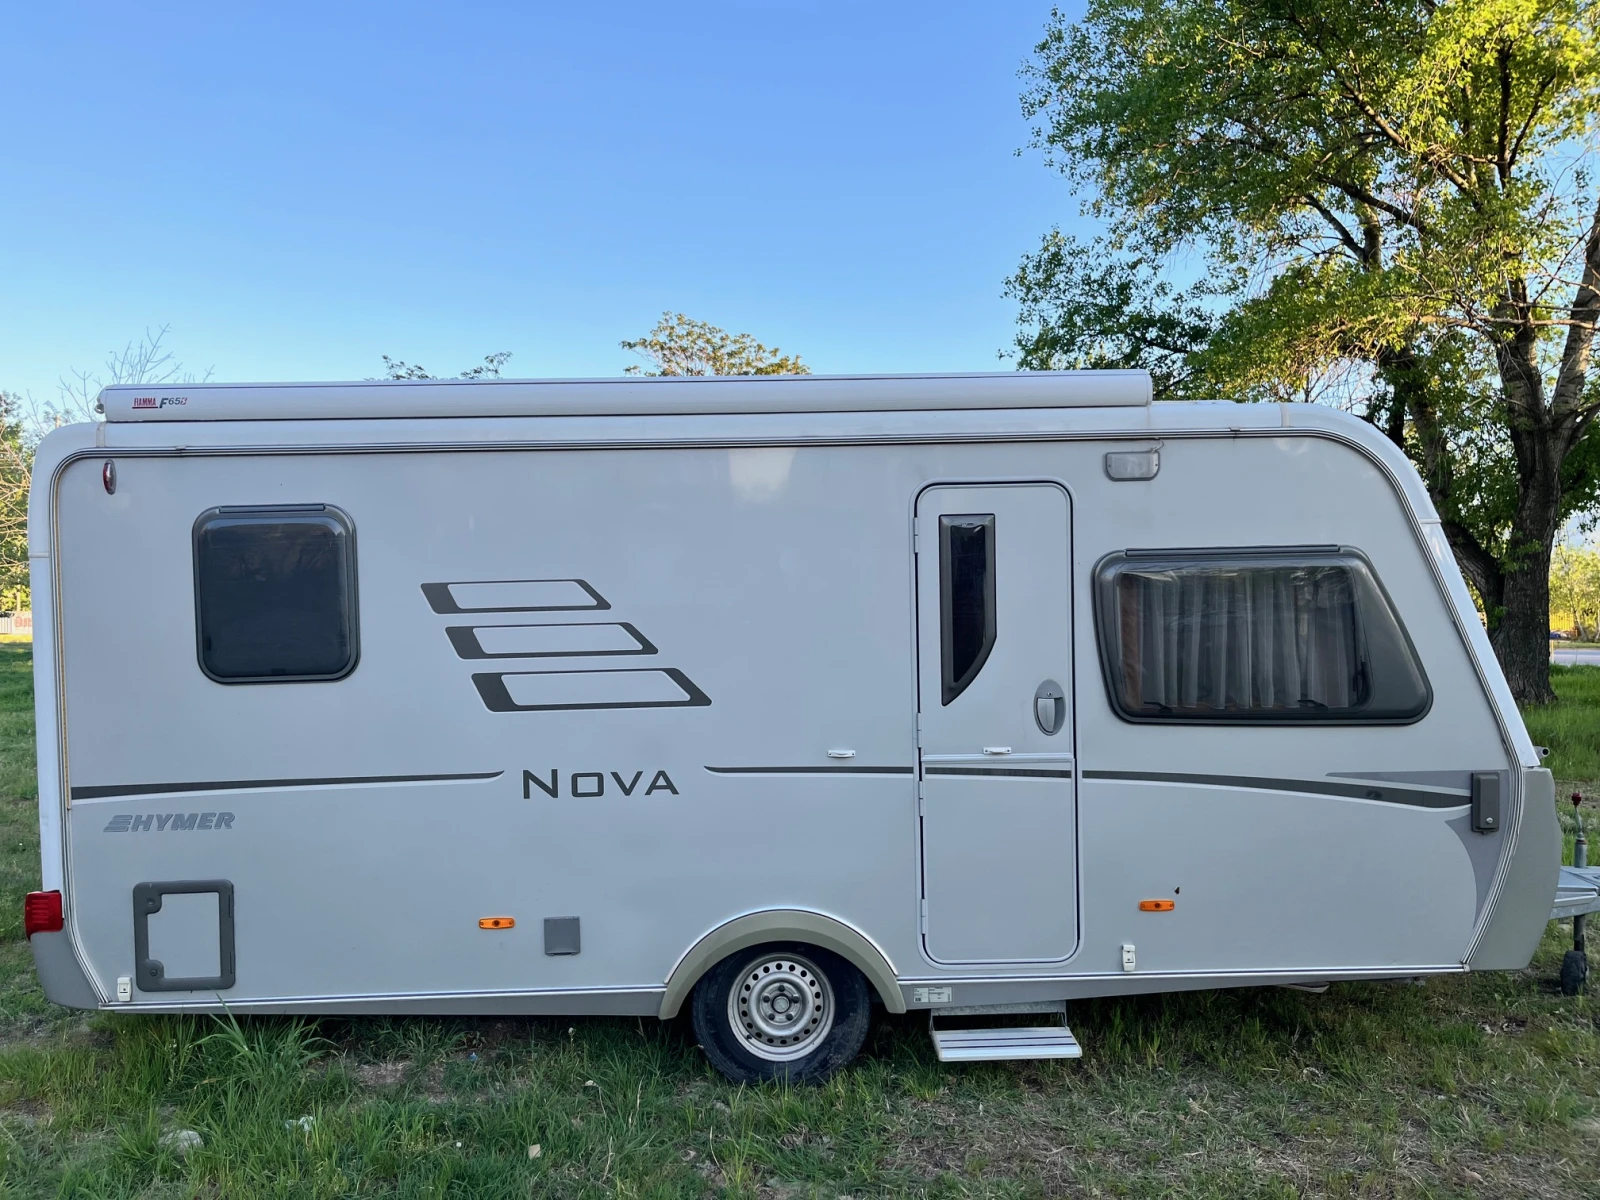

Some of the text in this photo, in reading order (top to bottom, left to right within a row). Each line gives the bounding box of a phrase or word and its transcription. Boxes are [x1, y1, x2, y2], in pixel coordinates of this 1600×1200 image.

[133, 397, 157, 407] FIAMMA
[522, 768, 680, 800] NOVA
[130, 811, 236, 833] HYMER
